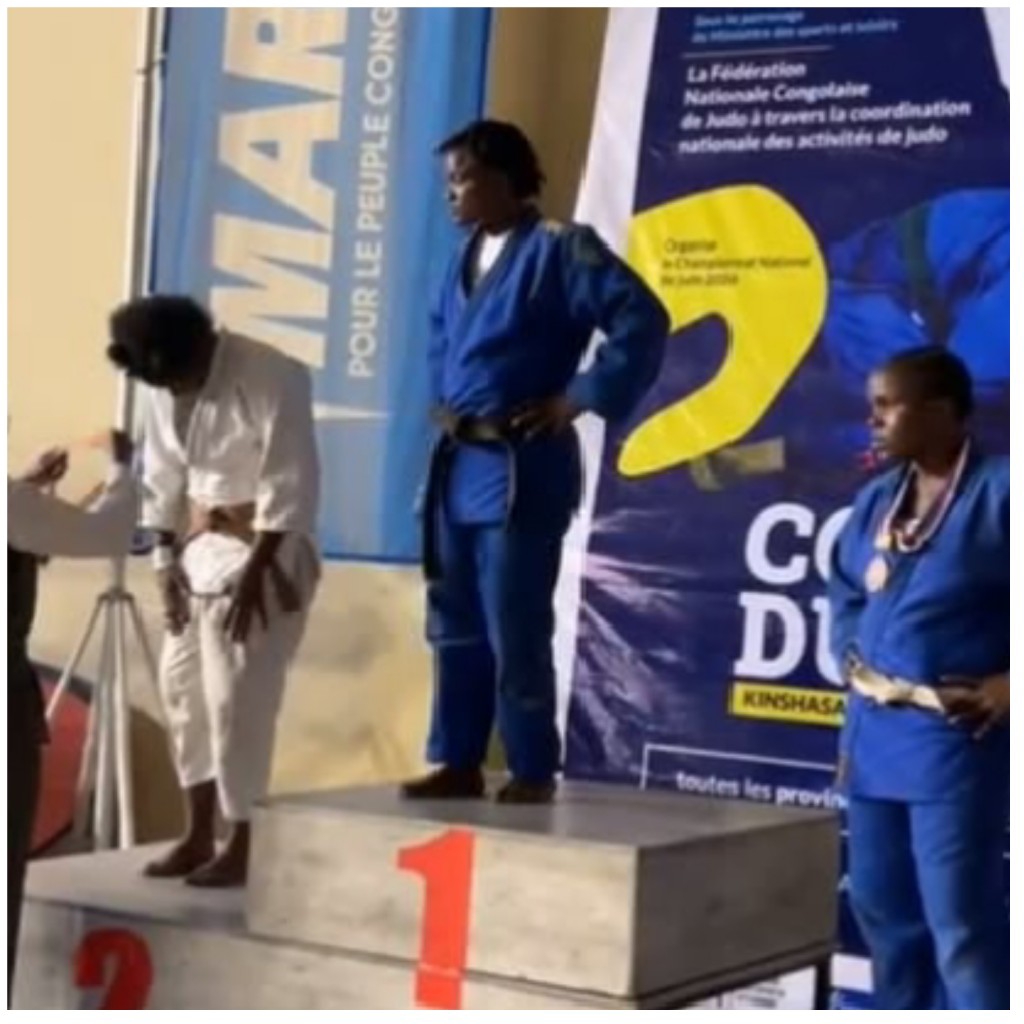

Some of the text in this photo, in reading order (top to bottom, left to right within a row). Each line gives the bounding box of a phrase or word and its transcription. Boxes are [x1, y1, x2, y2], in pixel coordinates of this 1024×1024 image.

[687, 61, 807, 83] La Fédération
[683, 81, 870, 106] Nationale Congolaise
[680, 110, 703, 130] de
[764, 107, 826, 126] travers
[829, 104, 847, 122] la
[849, 98, 972, 122] coordination
[678, 133, 761, 154] nationale
[763, 132, 794, 150] des
[796, 127, 874, 150] activités
[876, 127, 902, 146] de
[356, 113, 391, 232] PEUPLE
[353, 240, 383, 278] LE
[347, 286, 379, 378] POUR
[742, 690, 845, 715] KINSHASA
[676, 772, 740, 797] toutes
[743, 777, 771, 800] les
[396, 827, 475, 1009] 1
